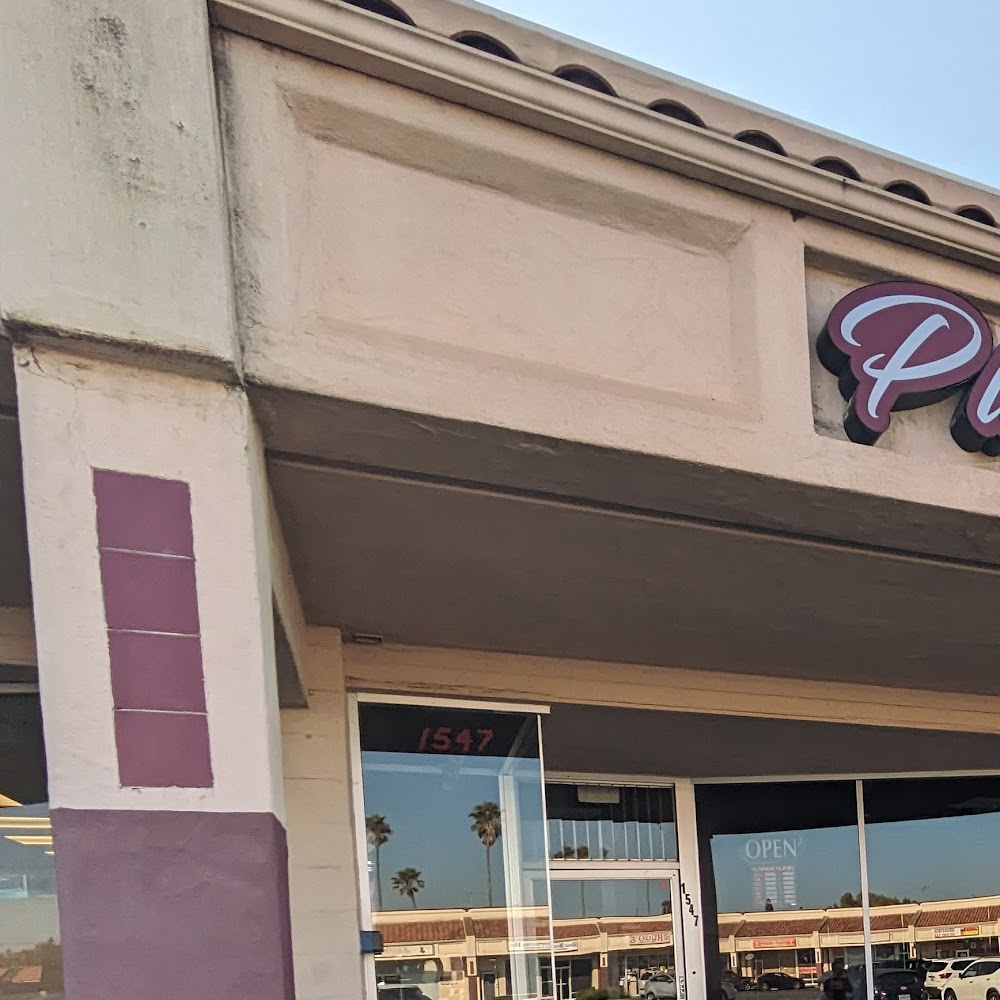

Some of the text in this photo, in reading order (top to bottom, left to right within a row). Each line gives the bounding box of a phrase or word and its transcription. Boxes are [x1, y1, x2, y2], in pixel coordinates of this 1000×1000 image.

[417, 726, 494, 752] 1547
[746, 839, 797, 859] OPEN
[681, 883, 699, 926] 1547
